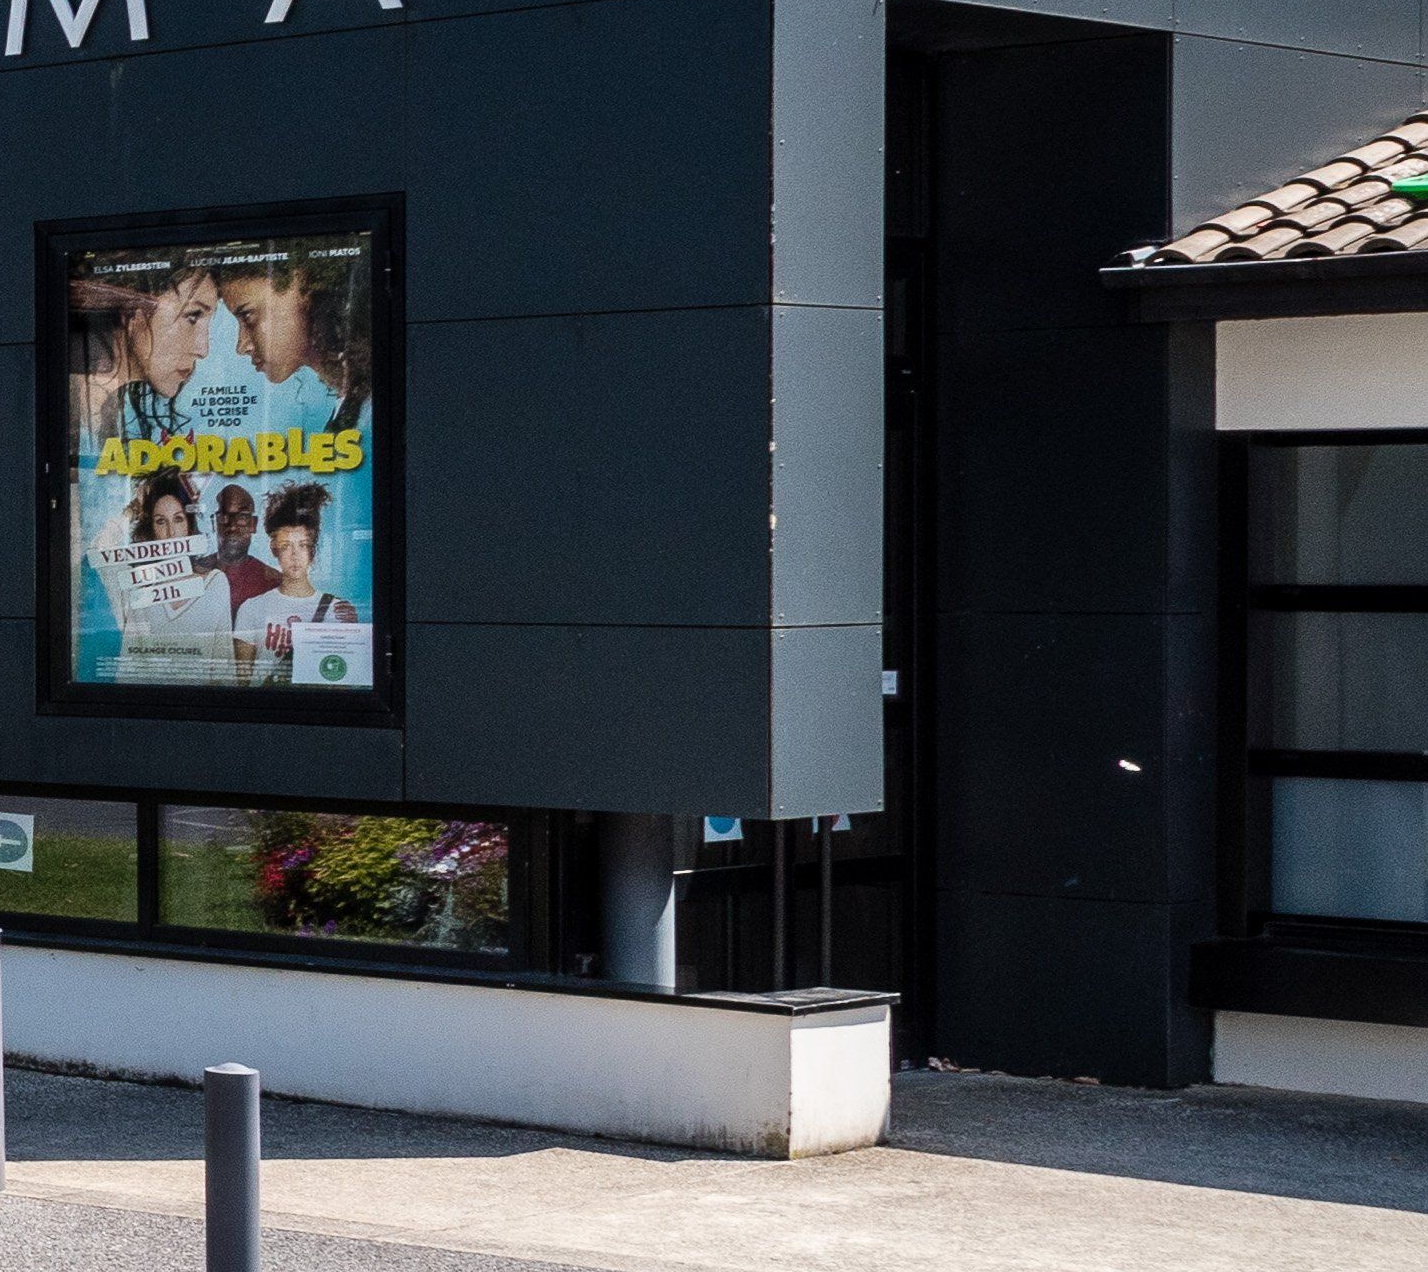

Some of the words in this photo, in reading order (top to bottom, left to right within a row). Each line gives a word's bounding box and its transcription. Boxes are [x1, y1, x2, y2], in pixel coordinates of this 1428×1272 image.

[201, 385, 247, 395] FAMILLE
[191, 396, 207, 407] AU
[208, 396, 240, 406] BORD
[242, 395, 258, 406] DE
[200, 407, 216, 417] LA
[217, 406, 249, 416] CRISE
[95, 426, 364, 476] ADORABLES
[101, 539, 191, 563] VENDREDI
[130, 561, 185, 585] LUNDI
[152, 585, 181, 602] 21h
